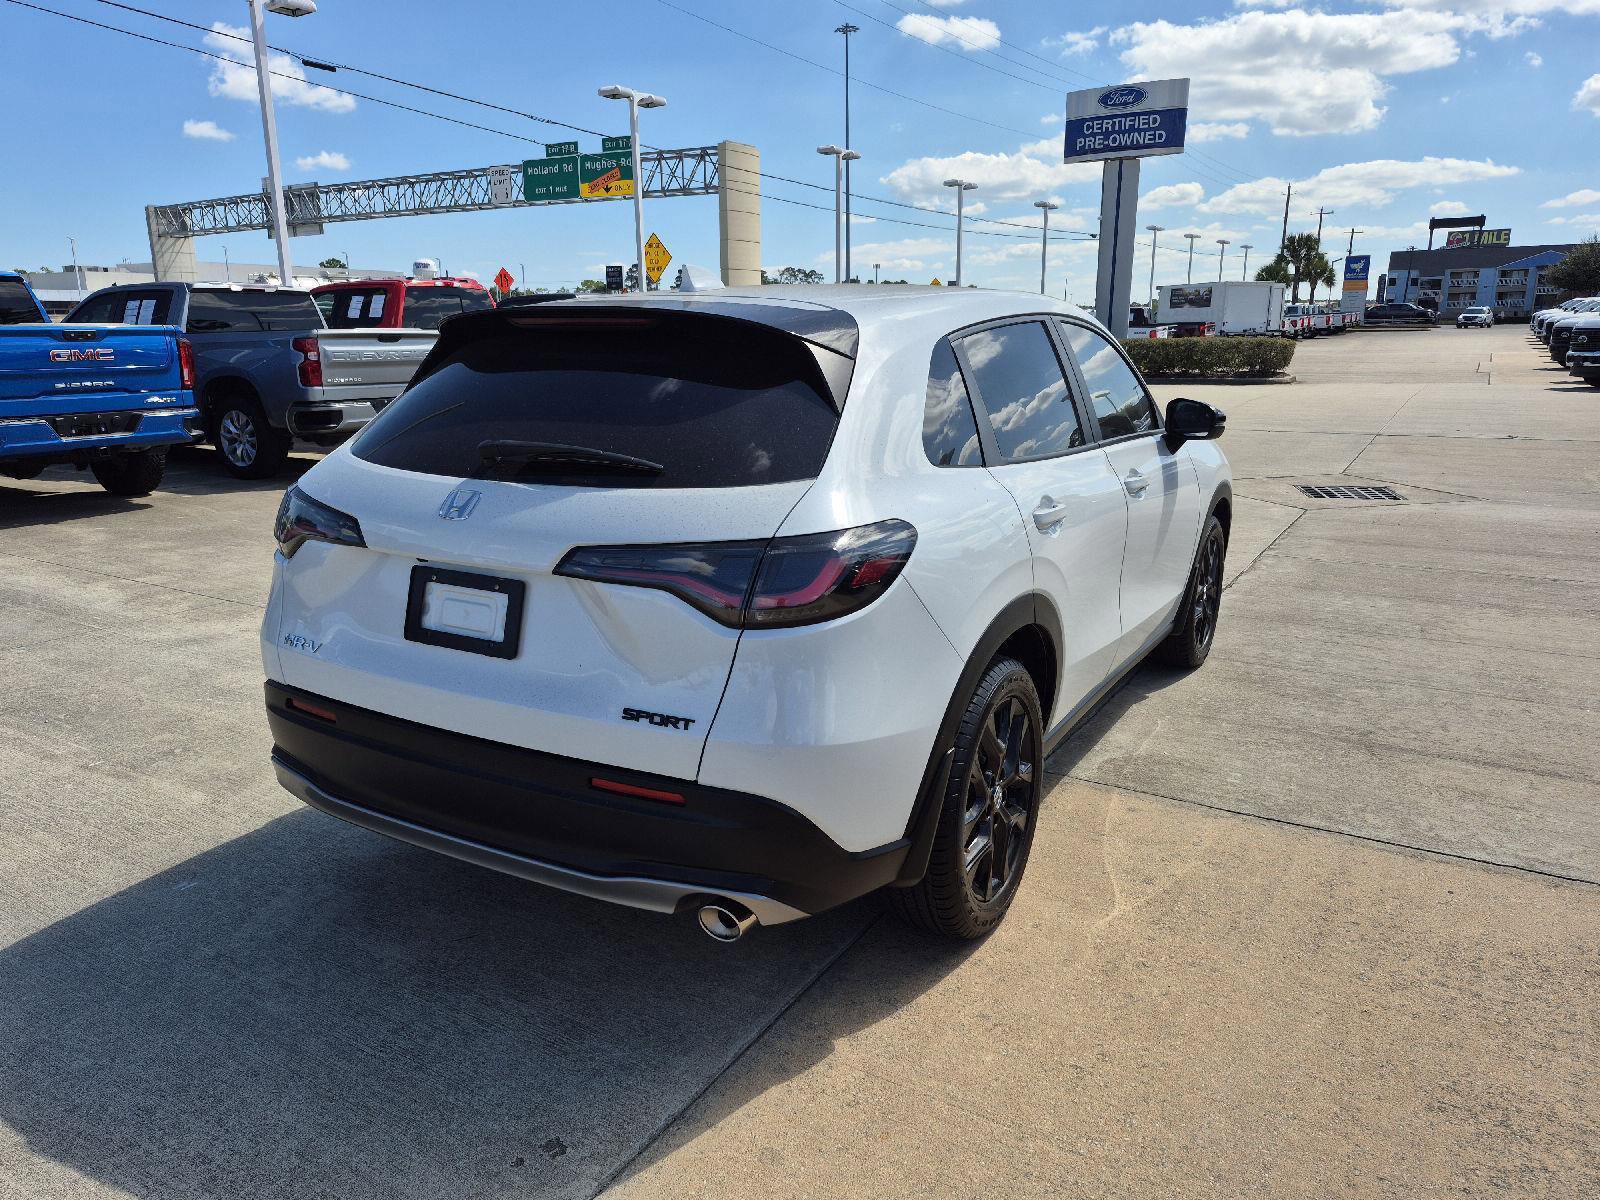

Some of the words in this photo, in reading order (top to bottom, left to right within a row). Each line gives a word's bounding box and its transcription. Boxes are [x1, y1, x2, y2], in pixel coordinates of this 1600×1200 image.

[1107, 90, 1136, 105] Ford
[1083, 114, 1161, 135] CERTIFIED
[1076, 130, 1167, 151] PRE-OWNED
[528, 164, 559, 175] Holland
[562, 163, 573, 172] Rd
[585, 159, 617, 171] Hughes
[49, 348, 115, 363] GMC
[283, 633, 323, 654] HR-V
[621, 707, 696, 731] SPORT
